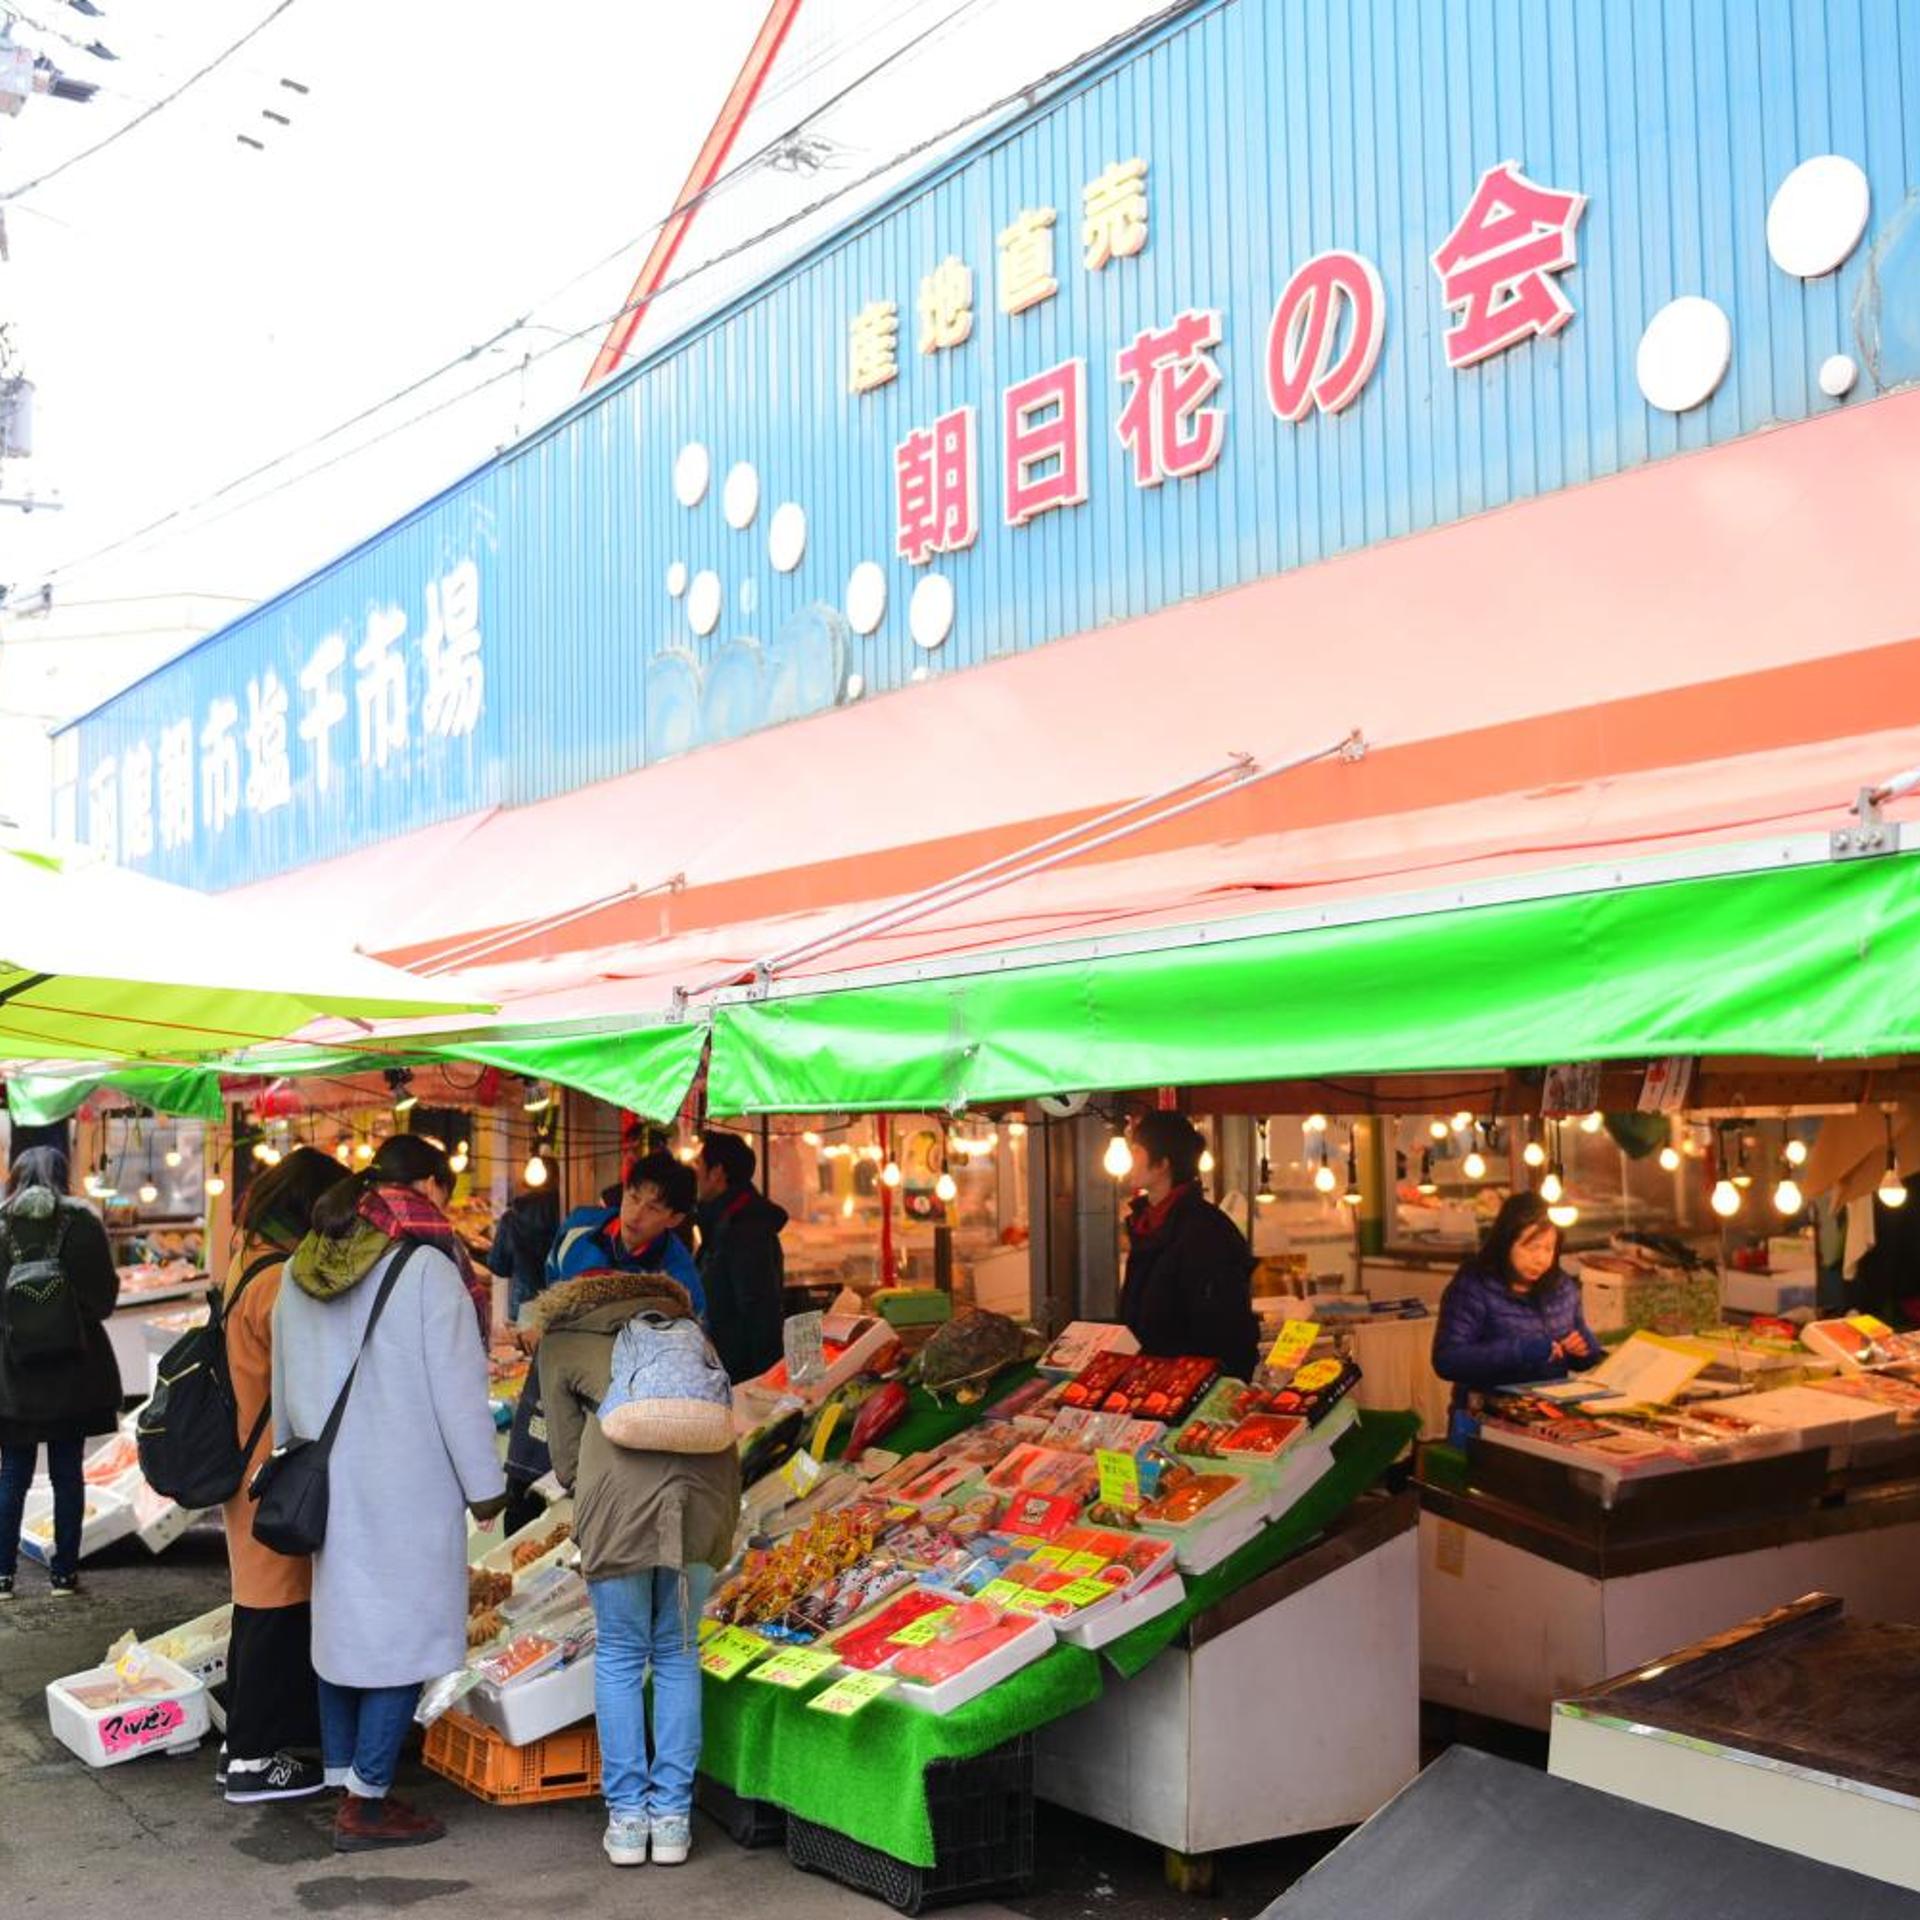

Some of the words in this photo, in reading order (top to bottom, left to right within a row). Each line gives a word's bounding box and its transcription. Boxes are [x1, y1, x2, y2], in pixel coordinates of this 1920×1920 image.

[849, 157, 1149, 397] 産地直売
[895, 160, 1588, 565] 朝日花の会
[267, 1767, 292, 1786] N
